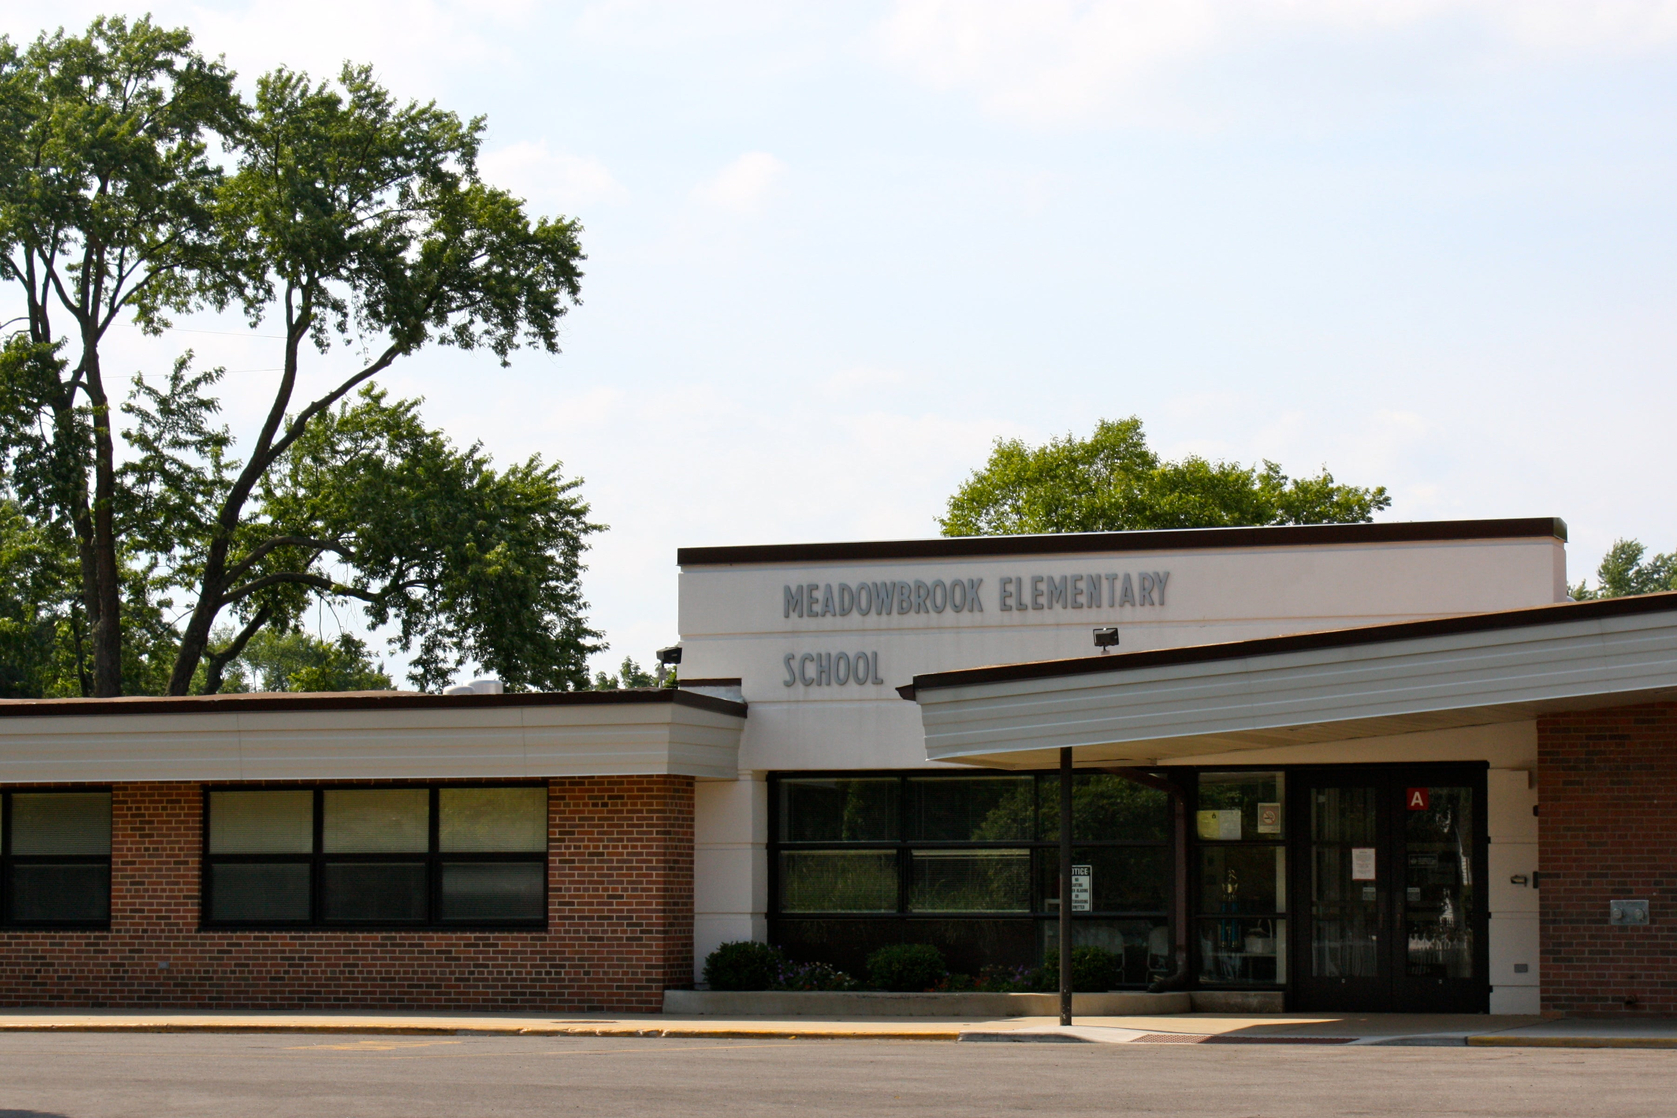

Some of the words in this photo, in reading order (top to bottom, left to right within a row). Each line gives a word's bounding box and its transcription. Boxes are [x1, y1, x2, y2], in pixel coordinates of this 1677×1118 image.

[783, 578, 984, 618] MEADOWBROOK
[999, 571, 1170, 612] ELEMENTARY
[783, 651, 884, 687] SCHOOL
[1410, 791, 1424, 807] A
